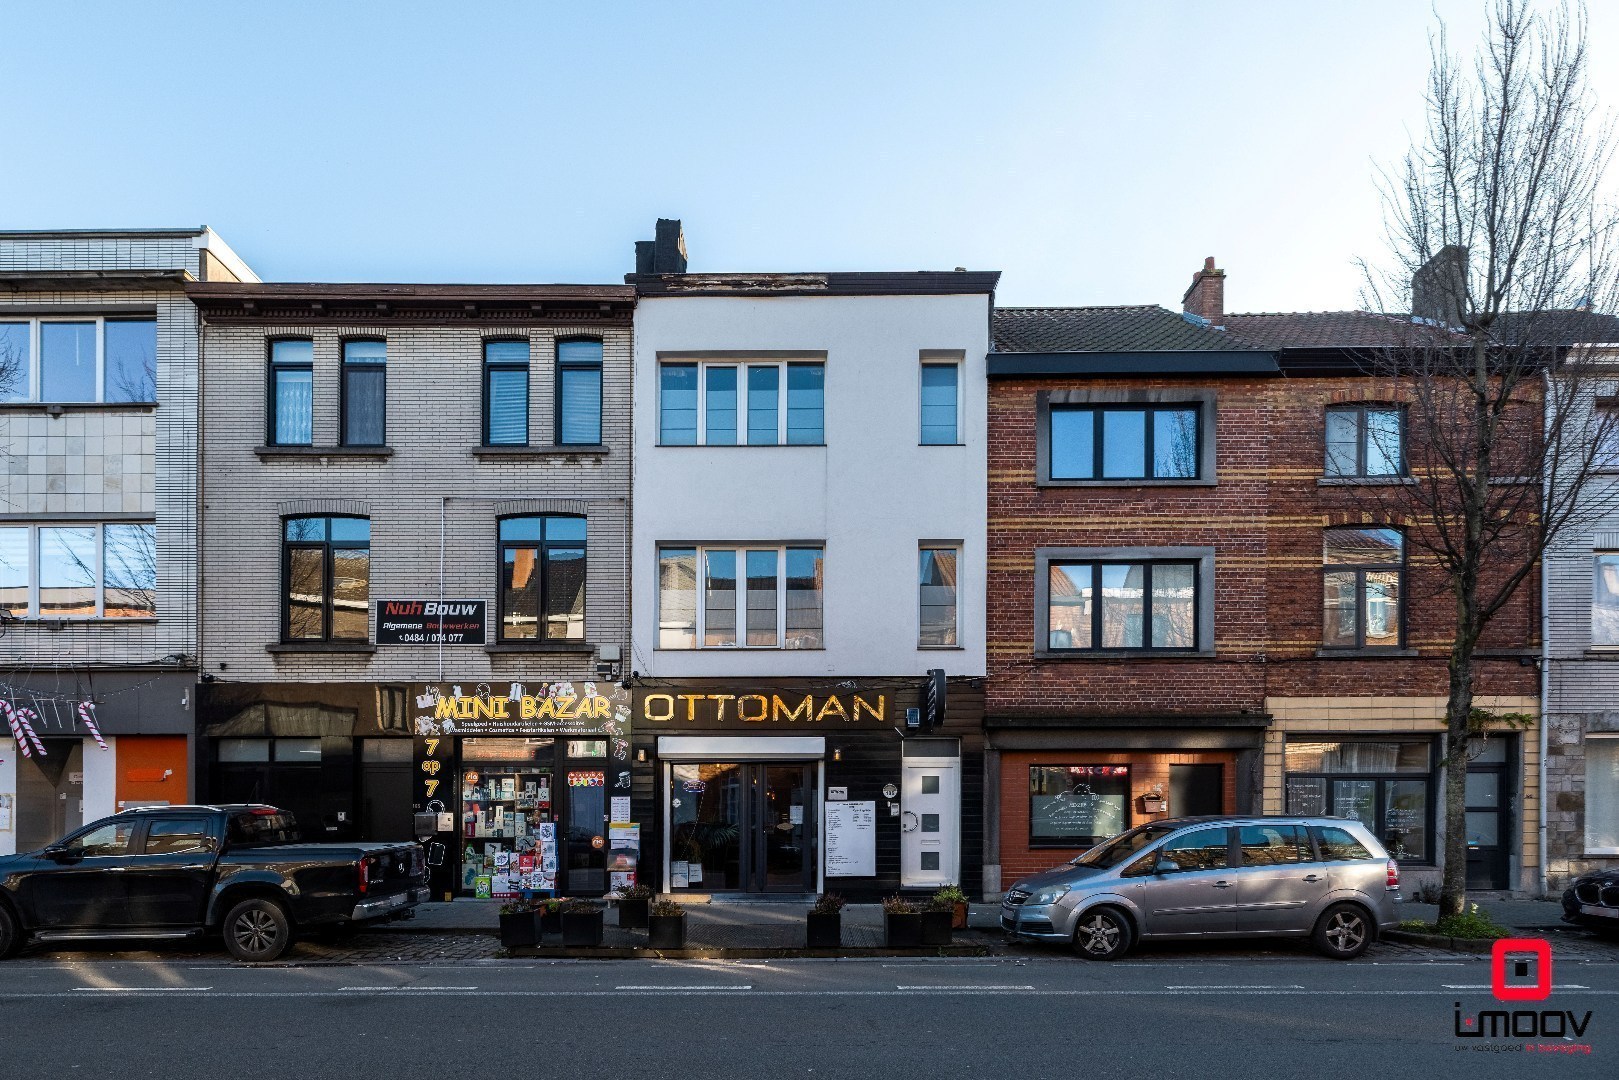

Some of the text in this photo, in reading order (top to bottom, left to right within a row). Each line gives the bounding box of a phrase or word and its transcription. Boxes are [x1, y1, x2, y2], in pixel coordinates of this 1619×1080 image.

[386, 601, 477, 616] Nuh Bouw
[383, 622, 423, 630] Algemene
[404, 633, 425, 642] 0484
[431, 633, 447, 642] 074
[448, 633, 464, 642] 077
[435, 695, 612, 720] MINI BAZAR
[645, 694, 885, 722] OTTOMAN
[425, 738, 440, 756] 7
[421, 760, 440, 776] op
[425, 779, 440, 798] 7
